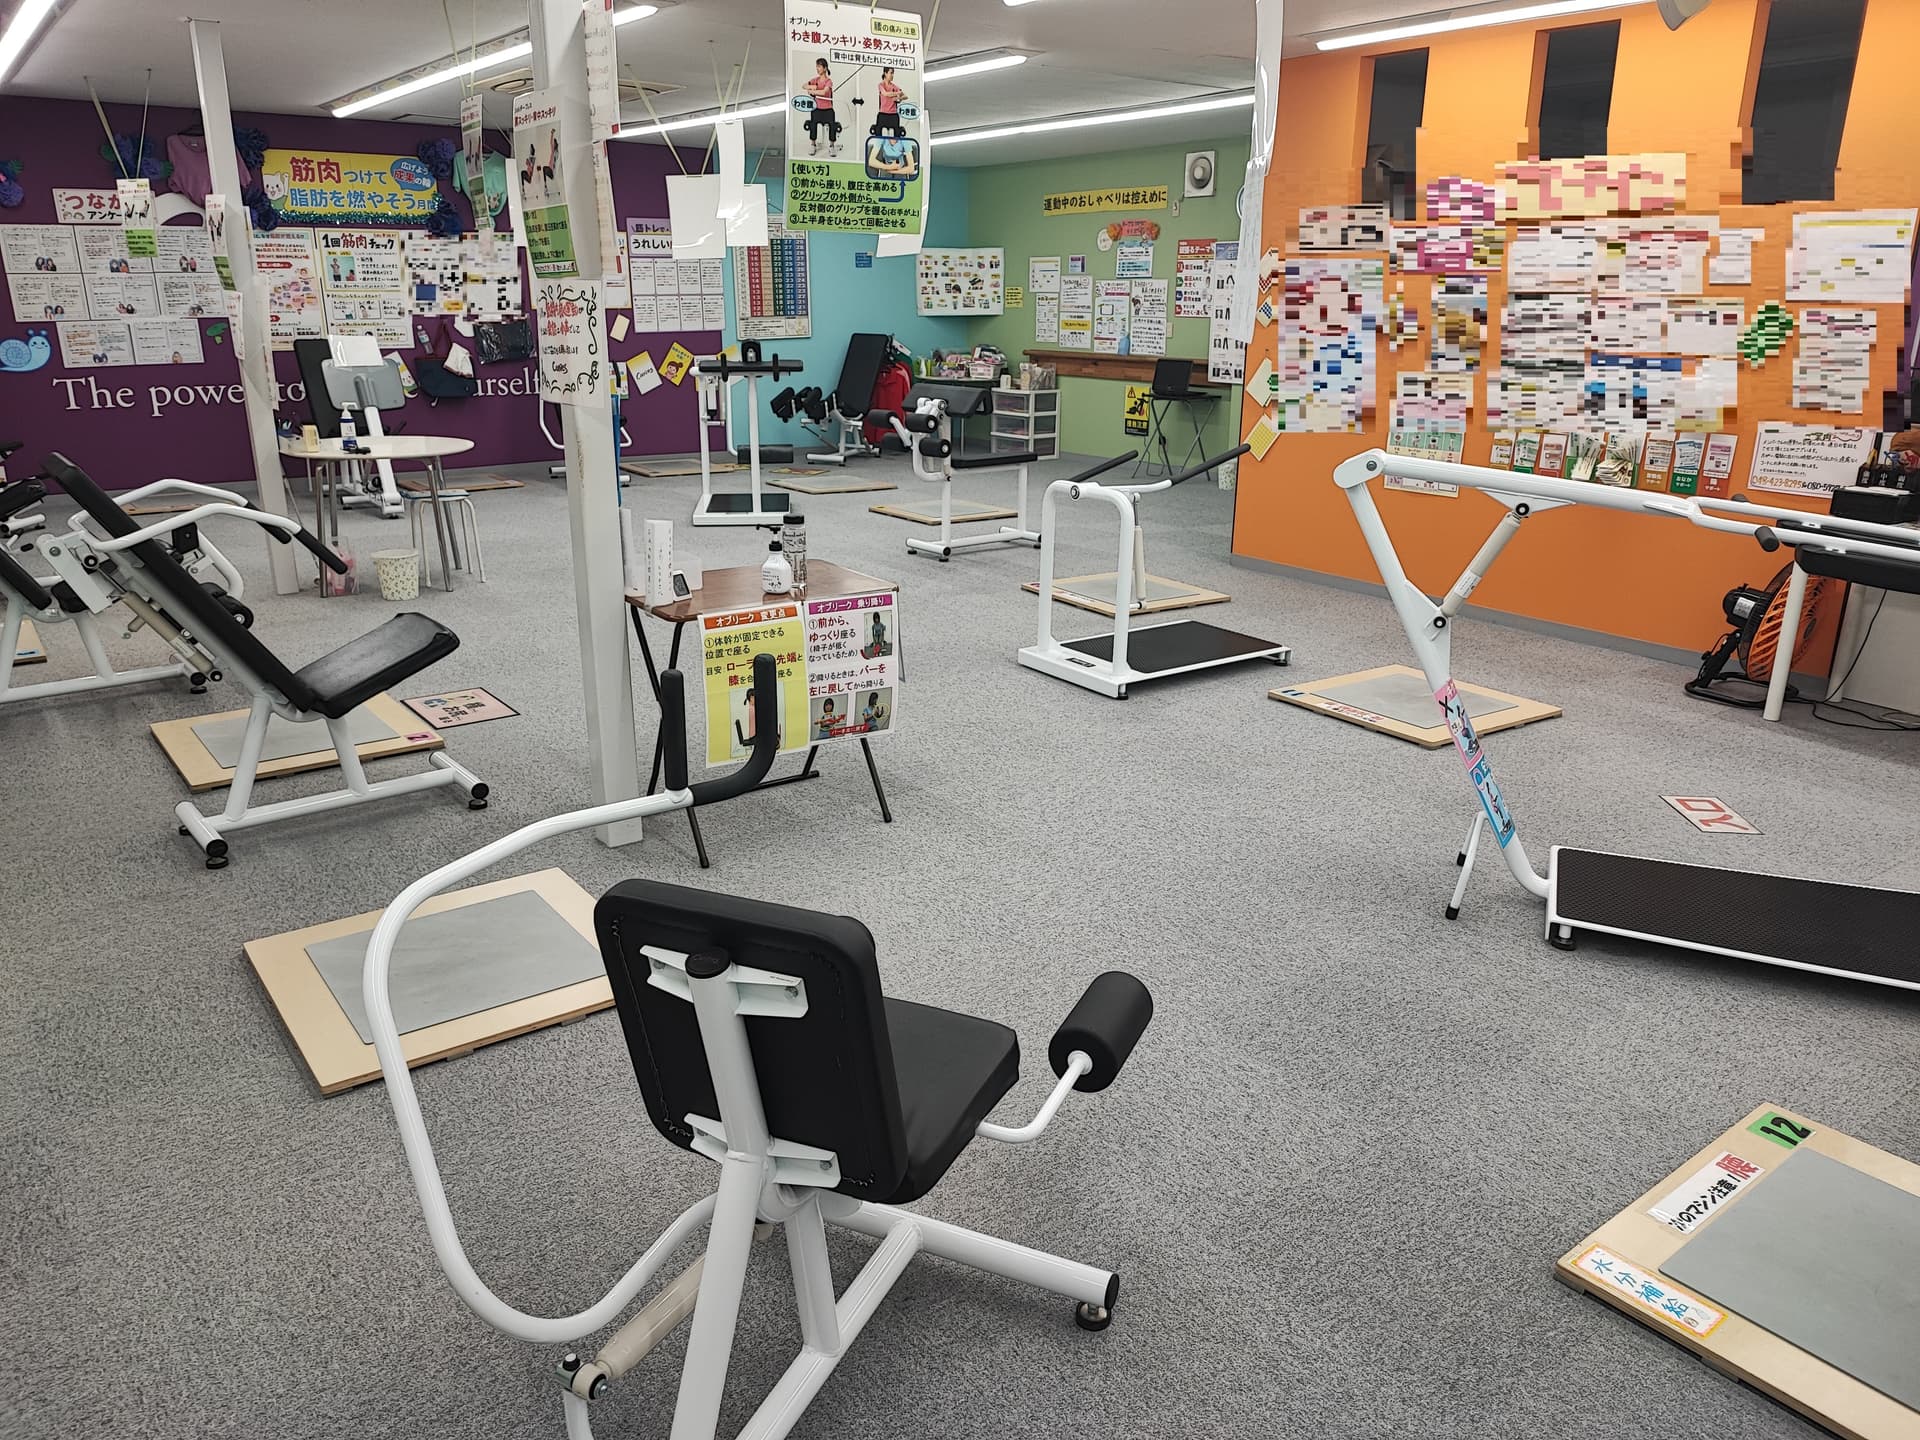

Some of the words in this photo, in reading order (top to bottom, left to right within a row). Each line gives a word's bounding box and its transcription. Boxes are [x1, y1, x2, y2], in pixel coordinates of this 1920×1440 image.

[789, 17, 821, 27] オブリーク
[1043, 190, 1167, 211] 運動中のおしゃべりは控えめに
[632, 239, 672, 249] うれしい
[52, 376, 135, 410] The
[149, 382, 245, 417] powe
[277, 380, 306, 402] to
[817, 601, 852, 613] オブリーク
[716, 613, 754, 626] オブリーク
[809, 628, 856, 643] ゆっくり座る
[706, 645, 750, 659] 位置で座る
[1760, 1116, 1811, 1147] 12
[1591, 1257, 1689, 1319] 水分補給
